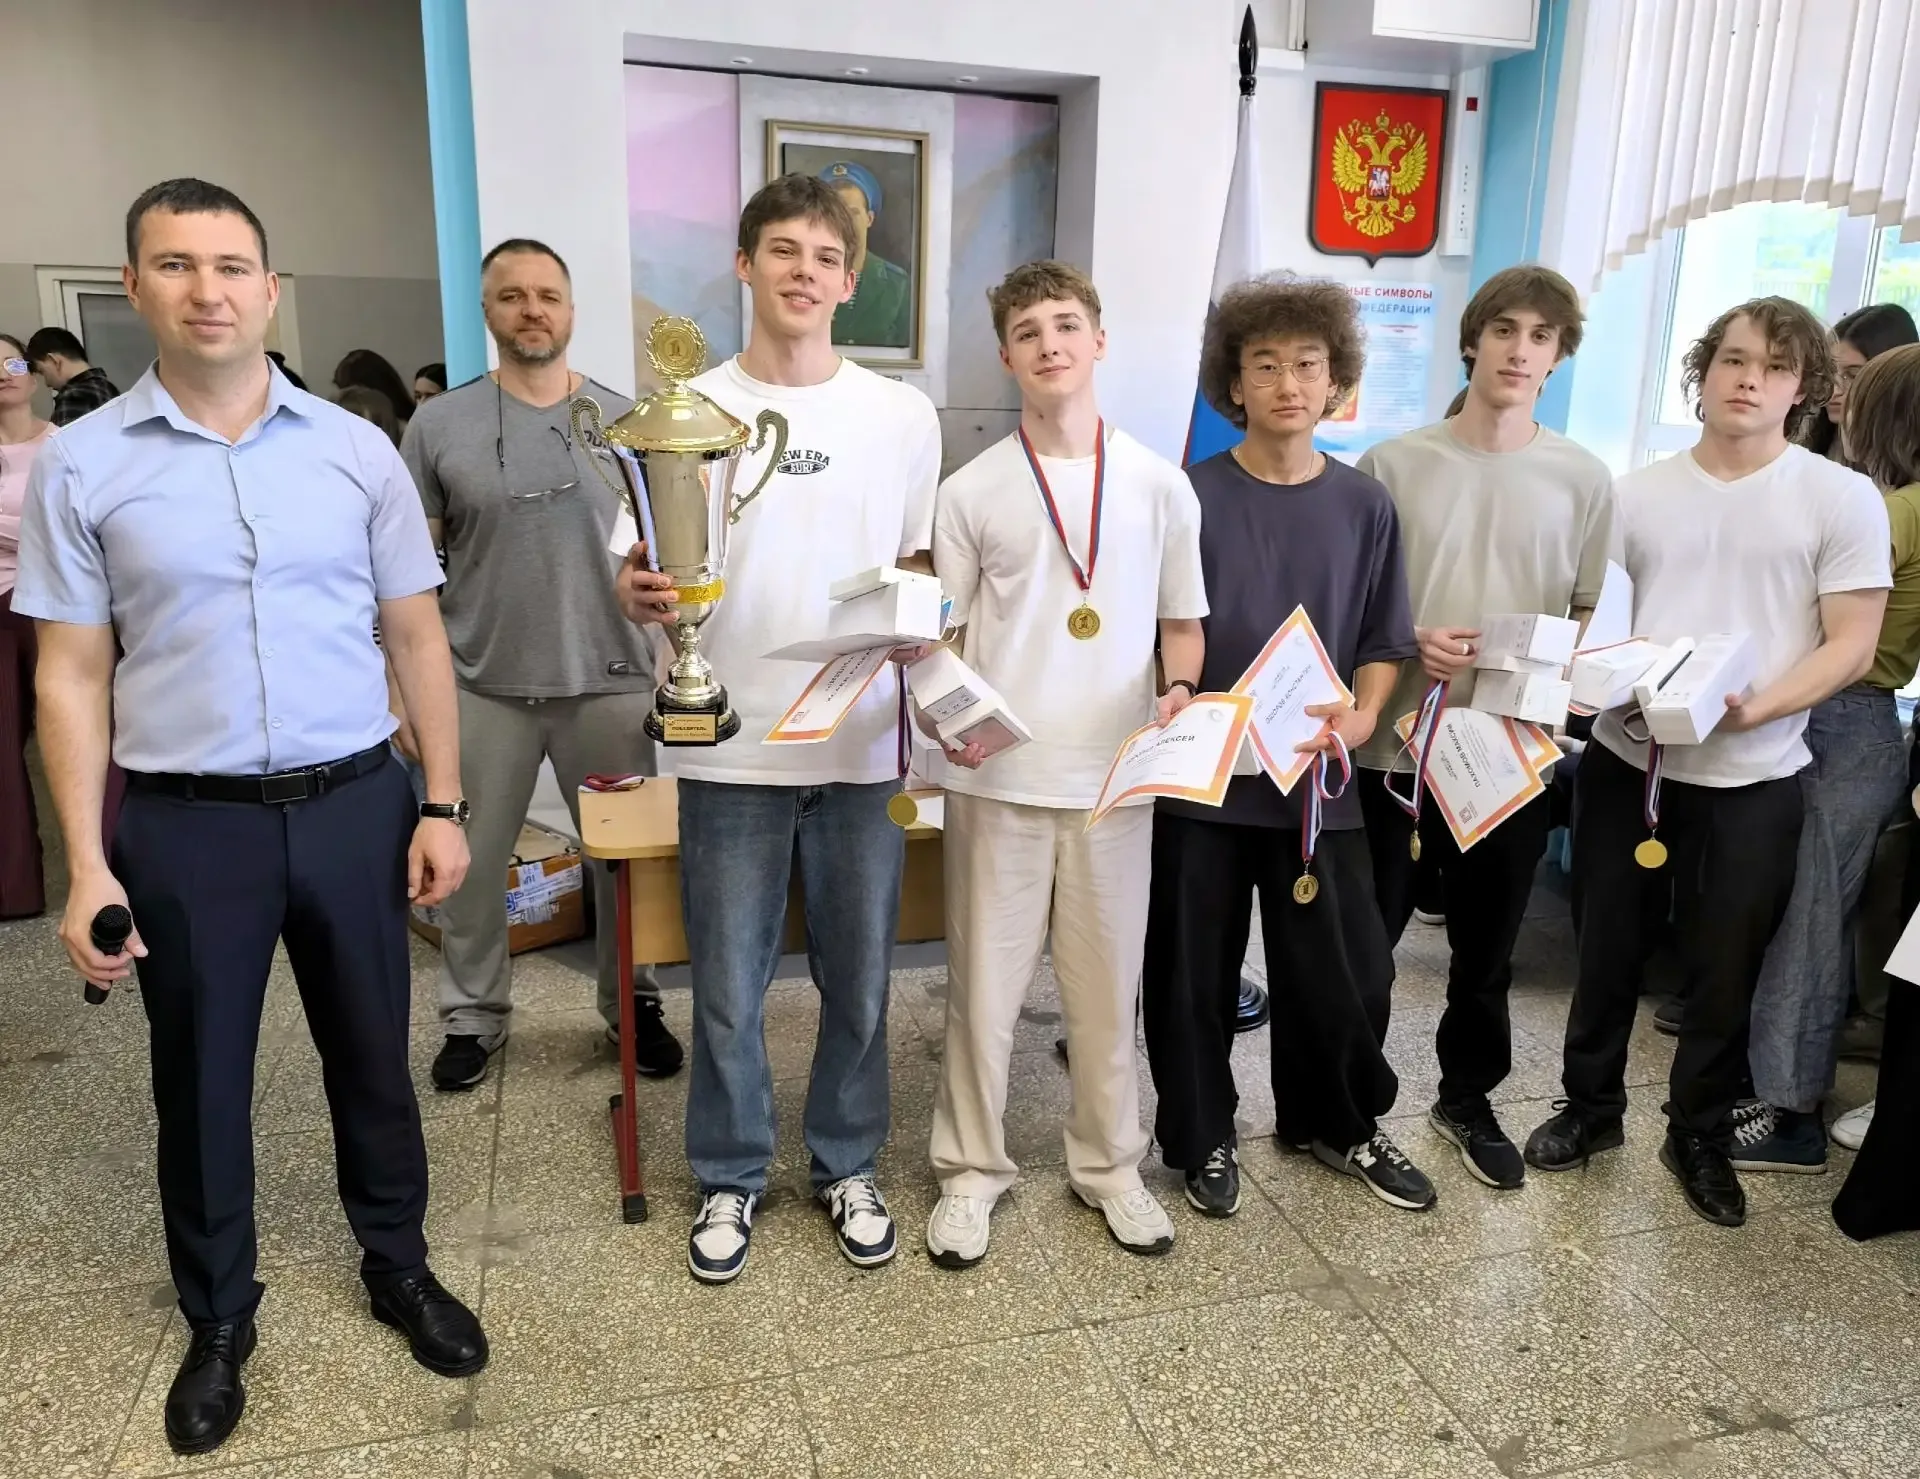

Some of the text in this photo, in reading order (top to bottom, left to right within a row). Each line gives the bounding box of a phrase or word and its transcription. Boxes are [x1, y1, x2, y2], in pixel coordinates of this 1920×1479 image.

[1345, 287, 1433, 299] НЫЕ СИМВОЛЫ
[778, 449, 830, 466] EW ERA
[790, 462, 815, 473] SURF
